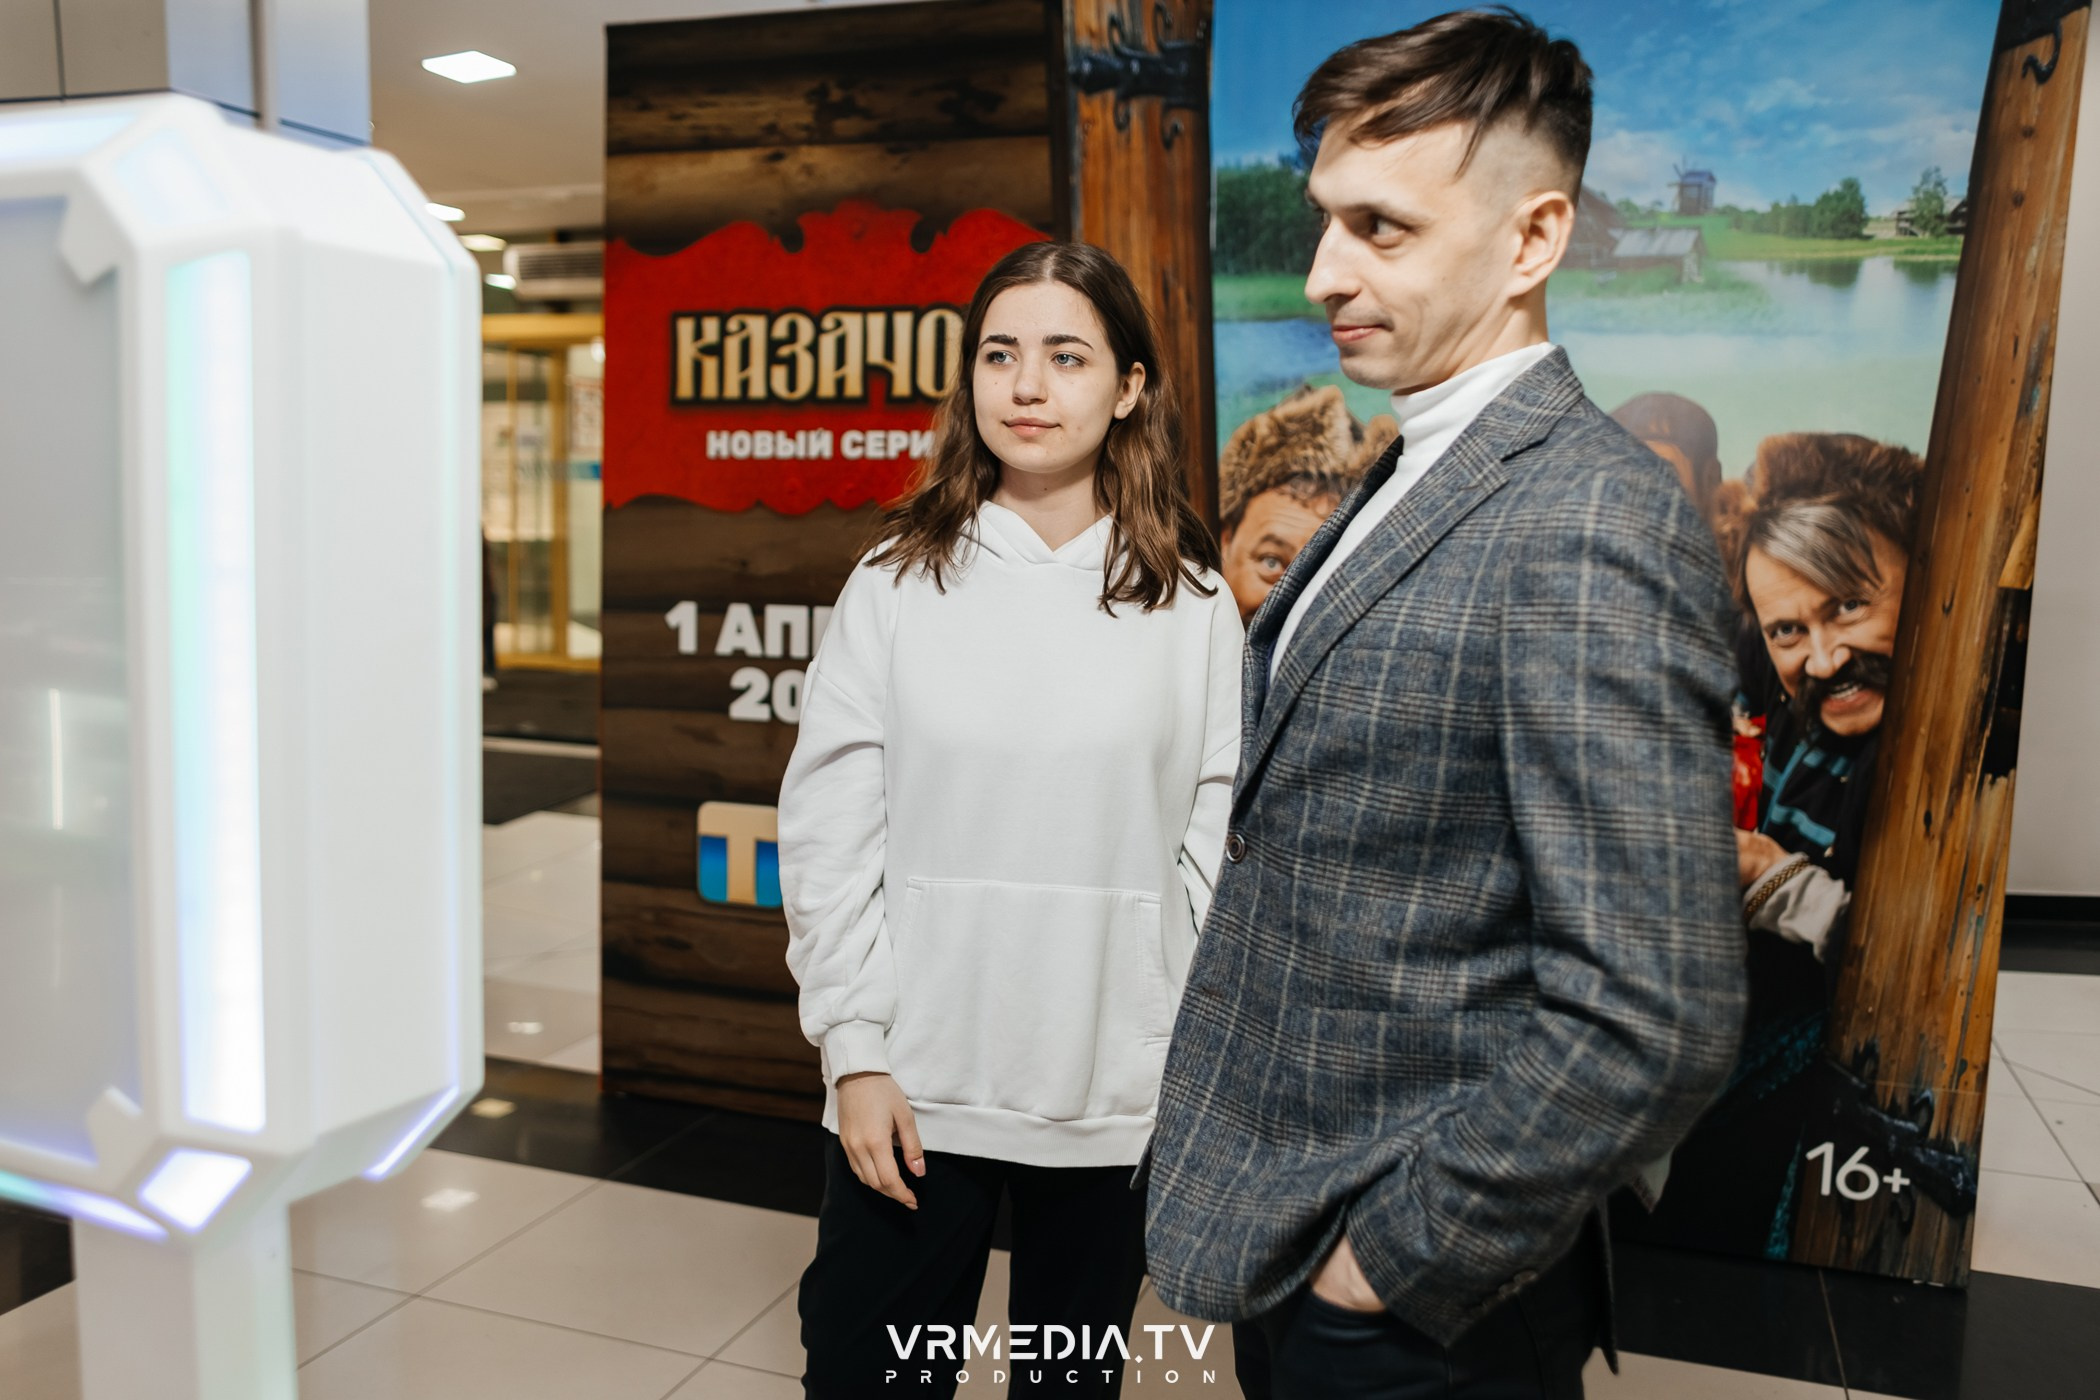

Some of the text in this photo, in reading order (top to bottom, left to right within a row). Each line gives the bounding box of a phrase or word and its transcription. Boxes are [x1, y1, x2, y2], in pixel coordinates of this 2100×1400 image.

[706, 428, 834, 460] НОВЫЙ
[664, 601, 698, 654] 1
[728, 666, 806, 724] 20
[1806, 1141, 1911, 1201] 16+
